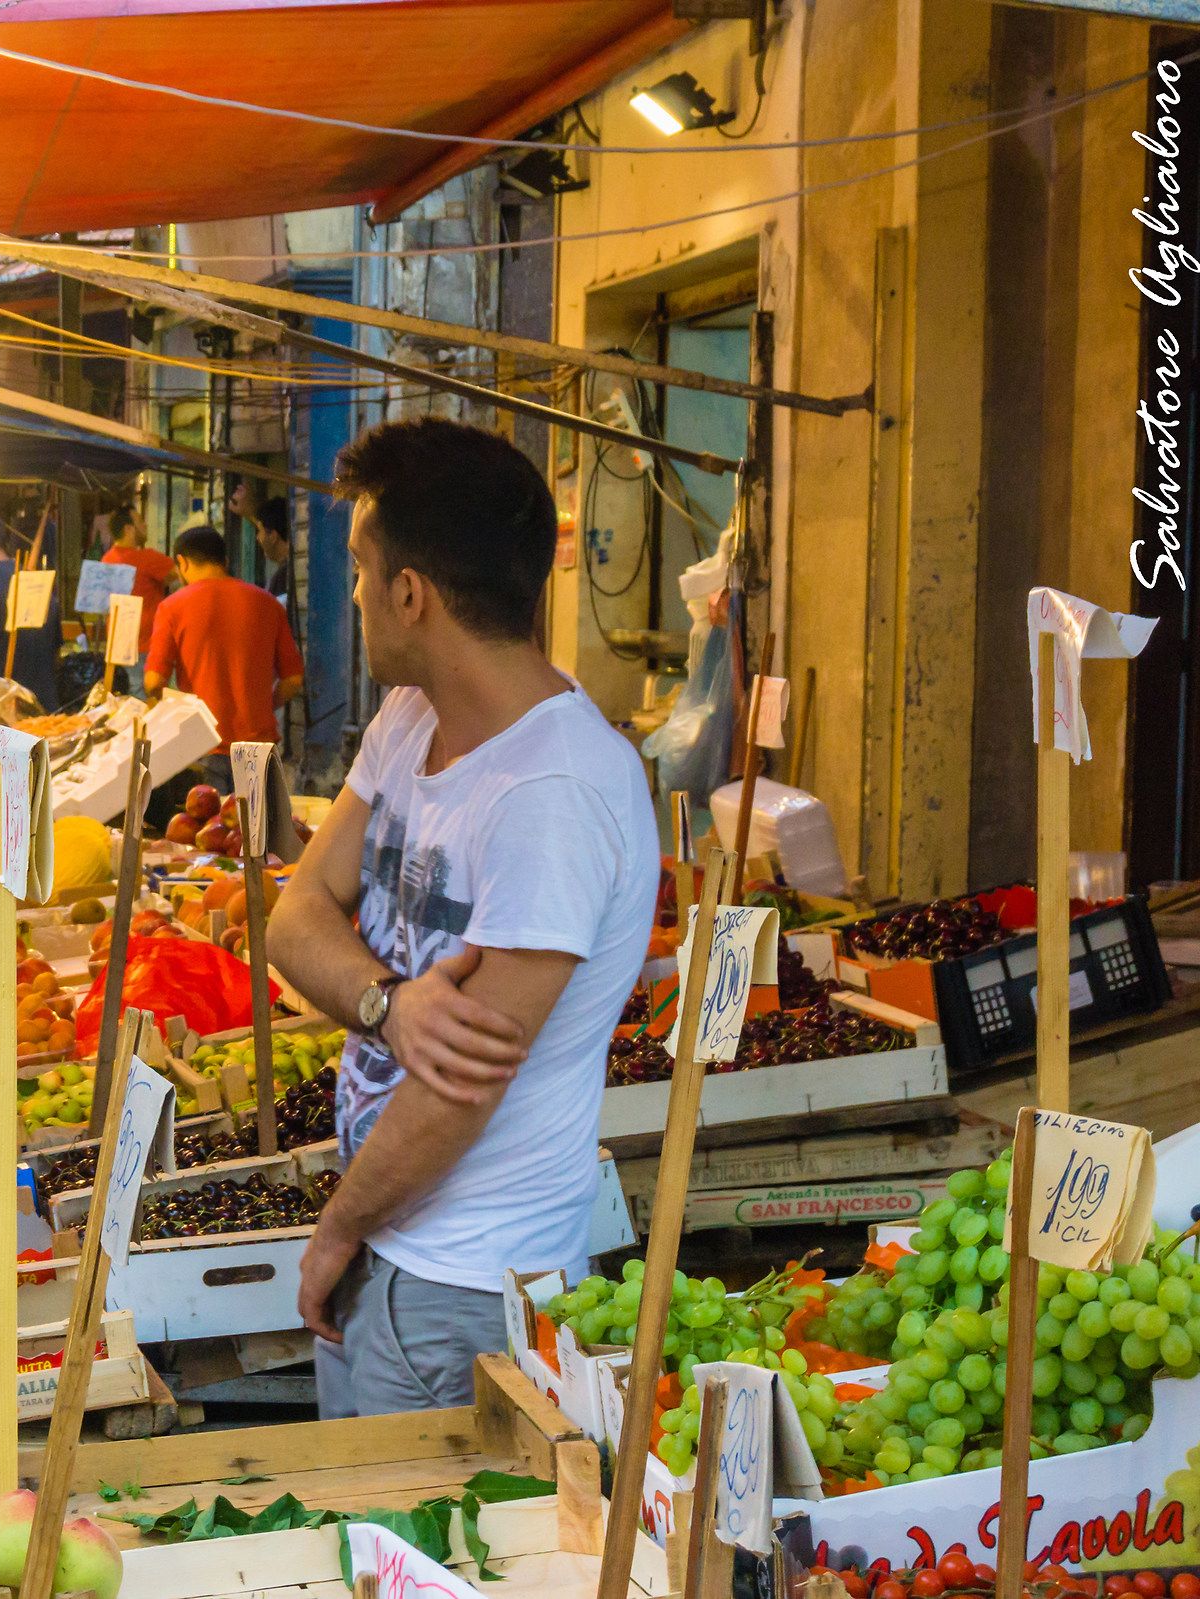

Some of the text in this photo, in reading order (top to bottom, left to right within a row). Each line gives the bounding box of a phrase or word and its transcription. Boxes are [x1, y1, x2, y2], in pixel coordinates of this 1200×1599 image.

[766, 1188, 821, 1201] Azienda
[752, 1195, 913, 1218] SAN FRANCESCO
[17, 1360, 53, 1374] UTTA
[17, 1377, 58, 1396] ALIA
